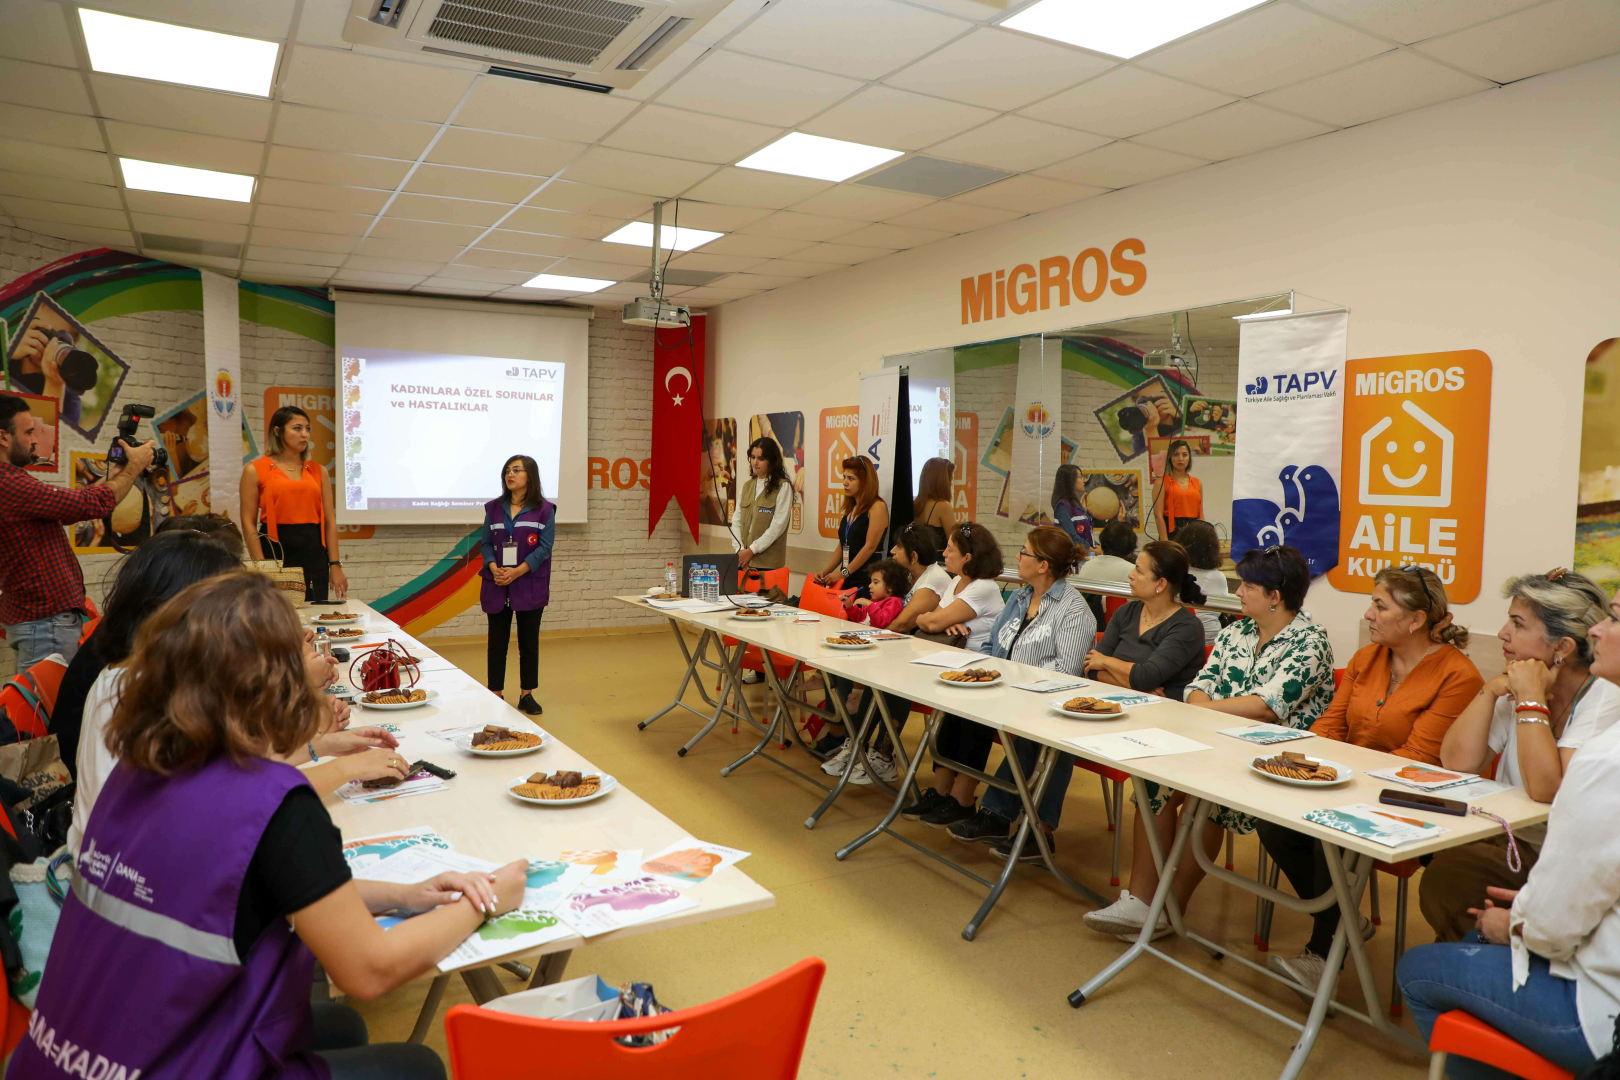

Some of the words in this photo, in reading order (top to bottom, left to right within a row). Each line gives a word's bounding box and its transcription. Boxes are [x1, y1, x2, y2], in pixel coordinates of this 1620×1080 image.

[961, 238, 1147, 325] MiGROS
[522, 367, 557, 379] TAPV
[1273, 370, 1337, 394] TAPV
[1355, 366, 1465, 396] MiGROS
[391, 384, 461, 397] KADINLARA
[464, 386, 493, 398] ÖZEL
[495, 390, 554, 402] SORUNLAR
[390, 400, 405, 408] ve
[408, 400, 489, 412] HASTALIKLAR
[825, 413, 859, 429] MiGROS
[1349, 513, 1458, 556] AiLE
